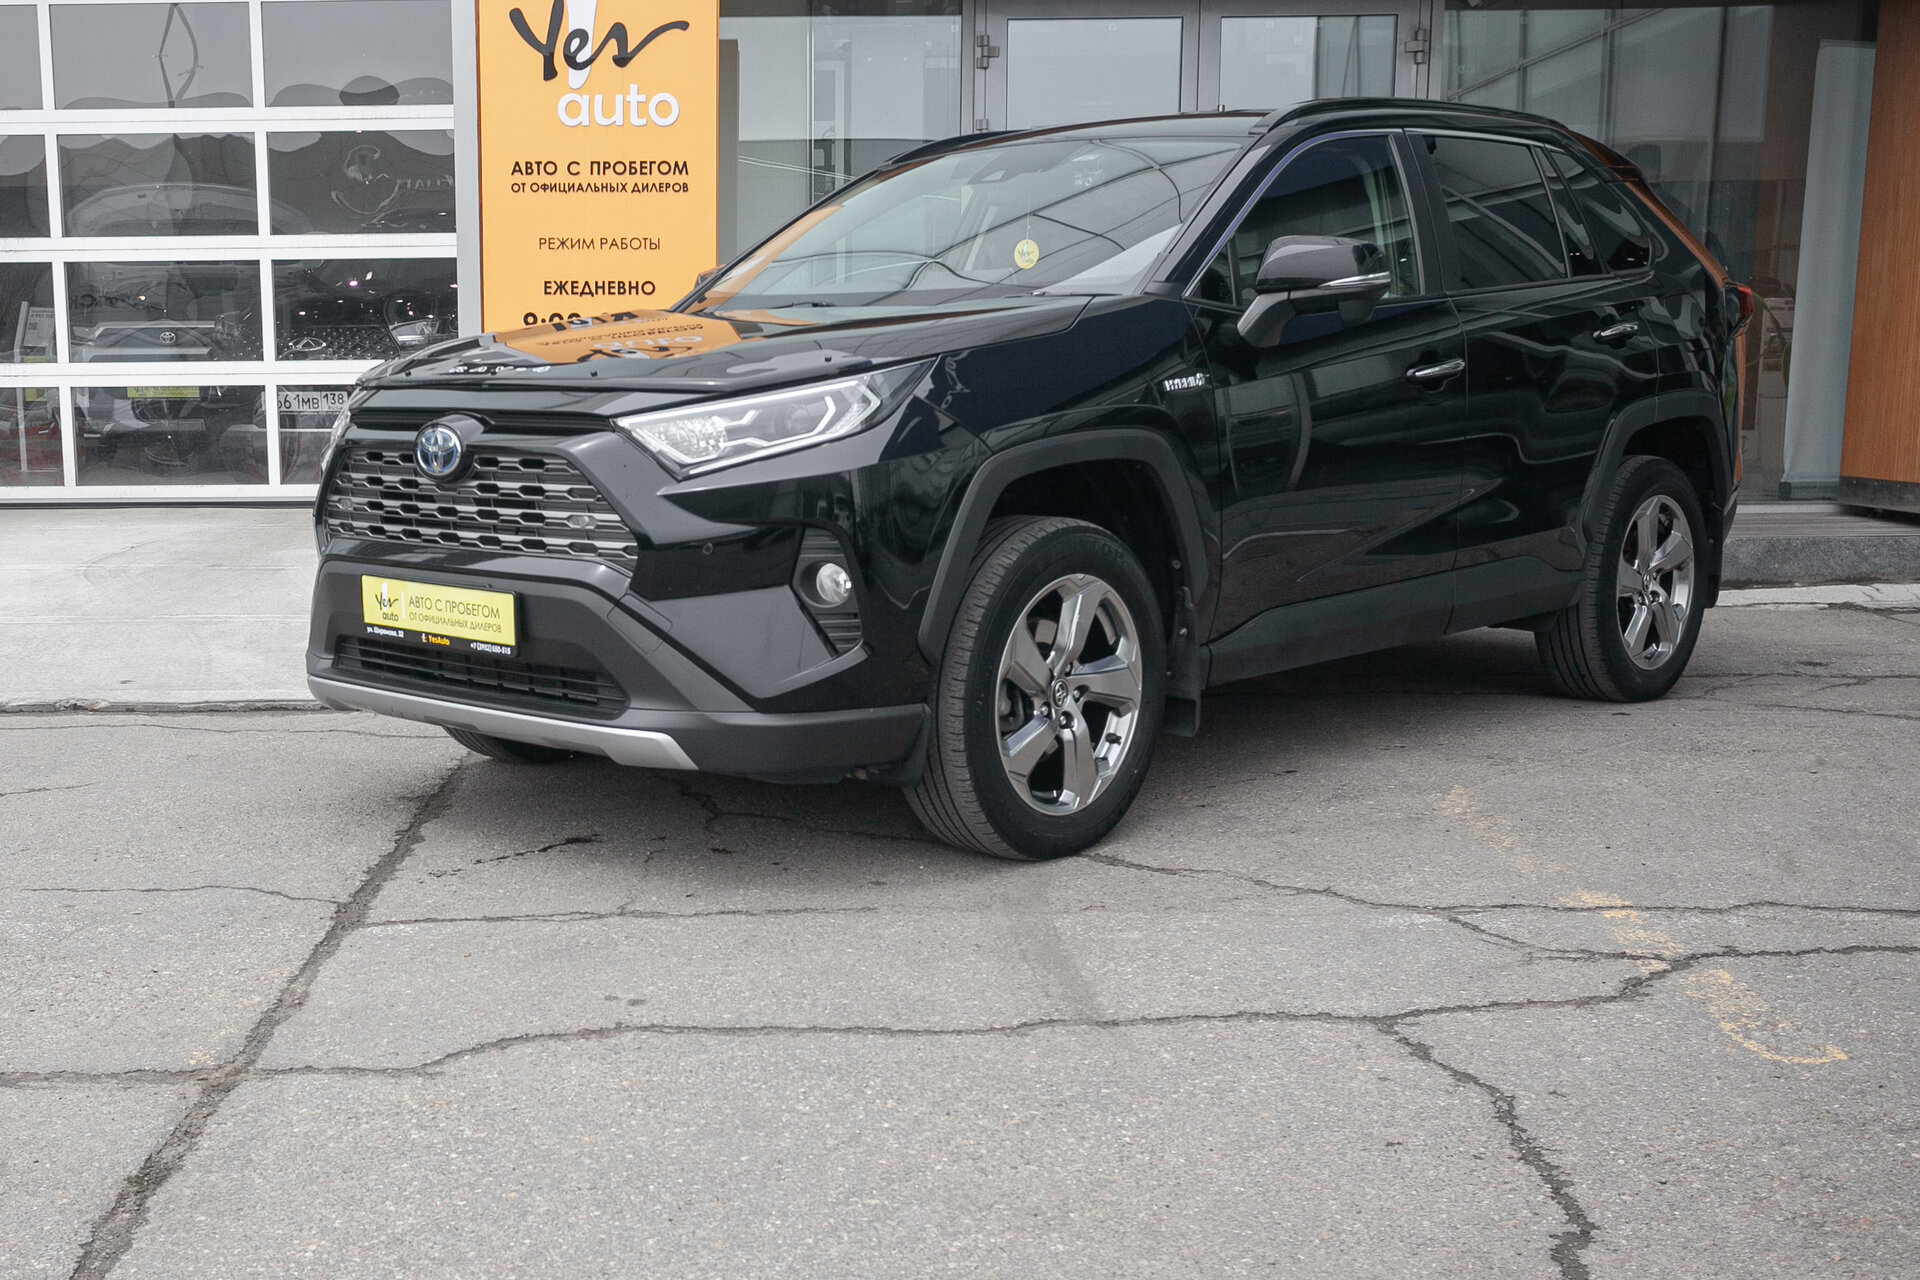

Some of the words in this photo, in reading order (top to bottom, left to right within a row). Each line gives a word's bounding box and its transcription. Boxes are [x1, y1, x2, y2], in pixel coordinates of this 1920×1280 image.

[509, 0, 690, 81] Yes
[557, 83, 680, 128] auto
[510, 160, 558, 176] АВТО
[566, 160, 581, 176] С
[590, 160, 689, 176] ПРОБЕГОМ
[510, 182, 526, 194] ОТ
[529, 181, 628, 195] ОФИЦИАЛЬНЫХ
[631, 182, 689, 194] ДИЛЕРОВ
[538, 237, 595, 251] РЕЖИМ
[599, 237, 661, 251] РАБОТЫ
[543, 280, 656, 297] ЕЖЕДНЕВНО
[322, 393, 344, 405] 138
[374, 591, 399, 611] Yes
[408, 596, 433, 611] АВТО
[434, 599, 443, 612] С
[445, 600, 500, 619] ПРОБЕГОМ
[382, 611, 399, 622] auto
[408, 612, 418, 621] ОТ
[419, 614, 469, 629] ОФИЦИАЛЬНЫХ
[470, 620, 502, 633] ДИЛЕРОВ
